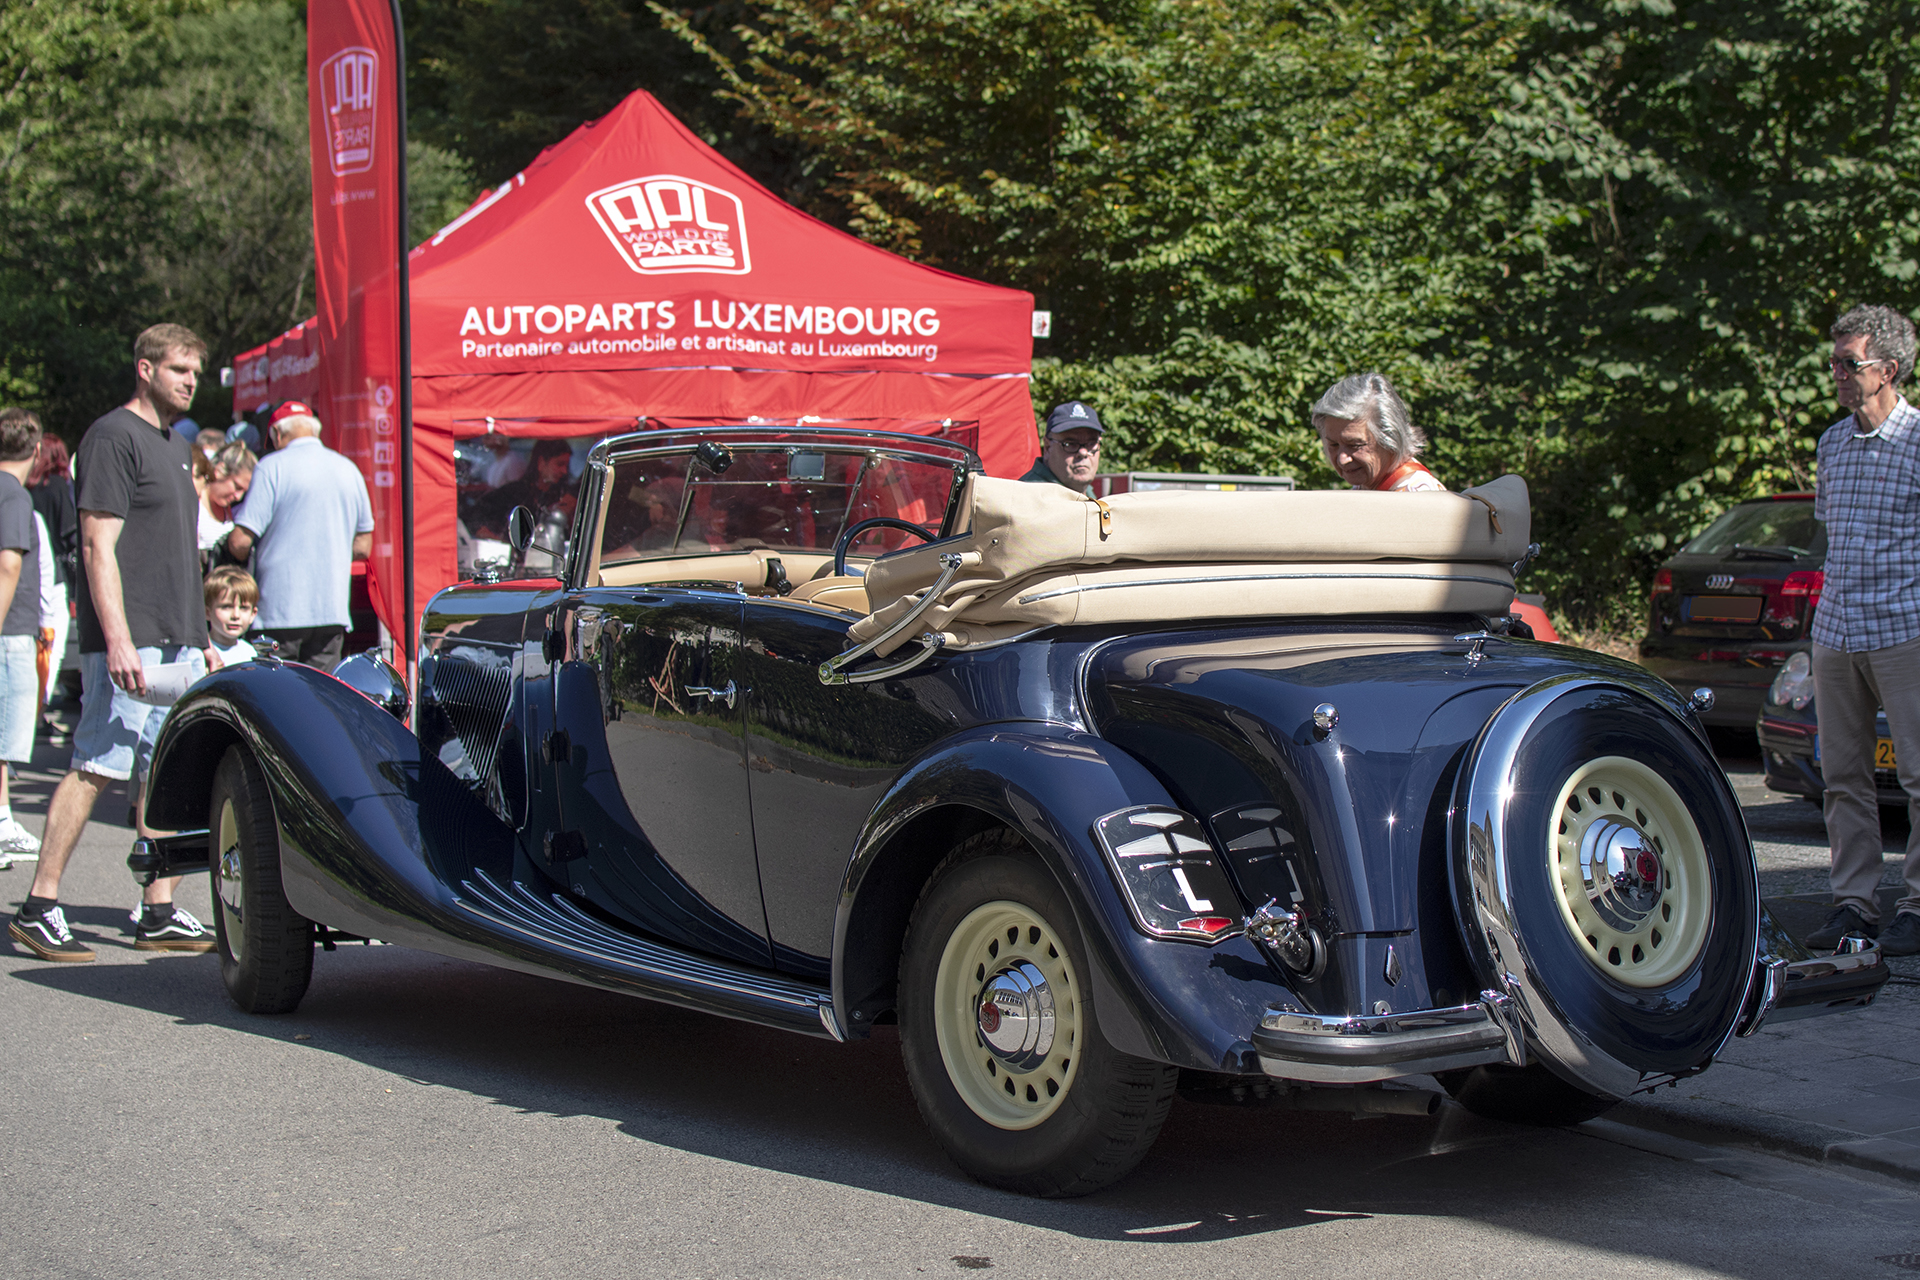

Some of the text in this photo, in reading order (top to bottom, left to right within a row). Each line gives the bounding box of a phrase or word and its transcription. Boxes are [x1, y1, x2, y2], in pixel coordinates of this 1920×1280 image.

[598, 181, 729, 233] APL
[623, 228, 729, 243] WORLD OF
[632, 239, 734, 258] PARTS
[459, 299, 940, 336] AUTOPARTS LUXEMBOURG
[462, 333, 938, 362] Partenaire automobile et artisanat au Luxembourg
[1172, 867, 1214, 912] L
